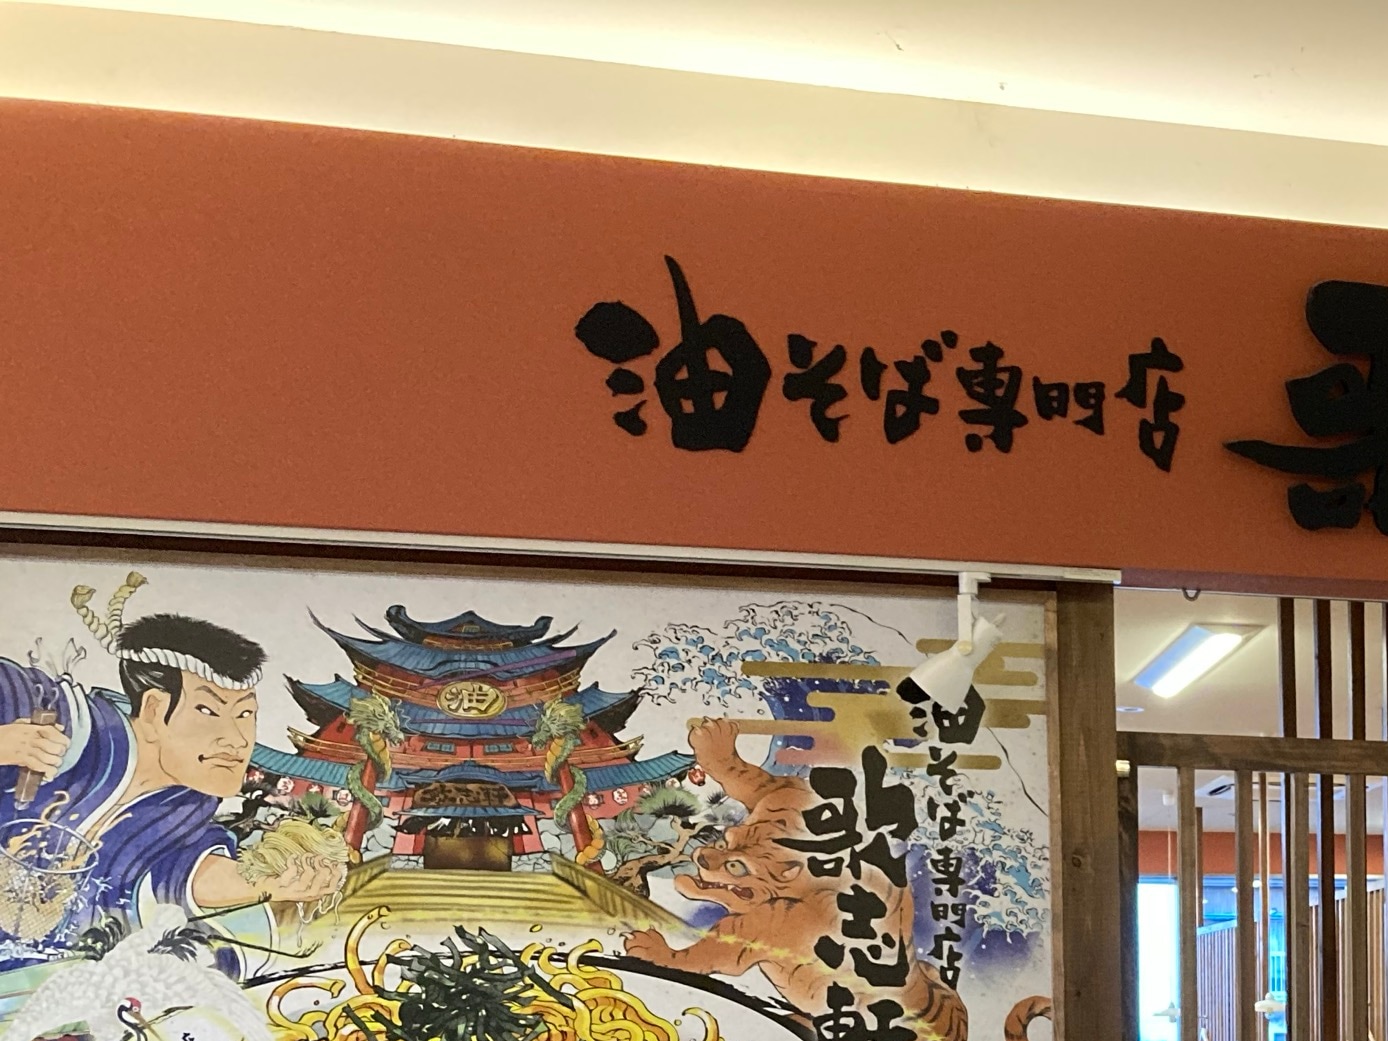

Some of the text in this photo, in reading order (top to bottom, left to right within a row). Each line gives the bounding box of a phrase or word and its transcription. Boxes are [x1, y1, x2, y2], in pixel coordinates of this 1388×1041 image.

[575, 253, 1187, 473] 油そば専門店
[897, 677, 985, 990] 油そば専門店
